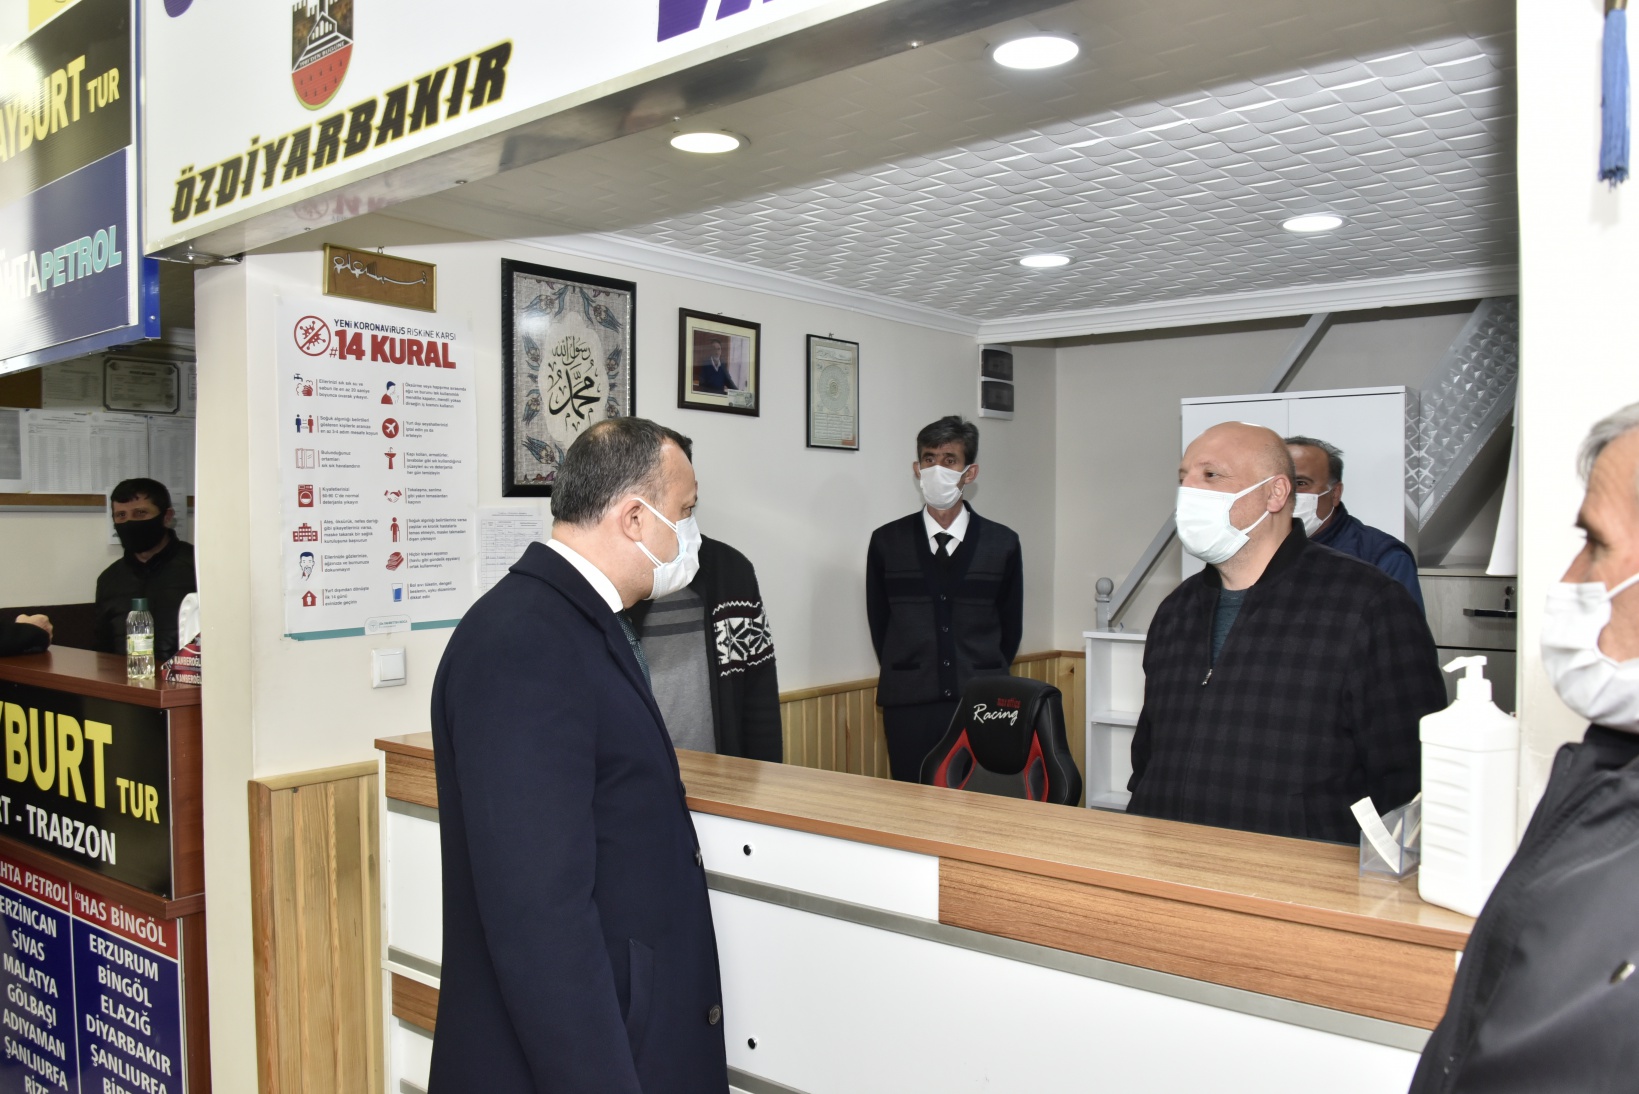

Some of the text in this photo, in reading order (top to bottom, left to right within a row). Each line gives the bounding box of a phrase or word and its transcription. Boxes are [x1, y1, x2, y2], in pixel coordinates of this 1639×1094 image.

[87, 67, 120, 113] TUR
[171, 38, 513, 225] ÖZDİYARBAKIR
[371, 334, 456, 369] KURAL
[973, 703, 1019, 726] Racing
[0, 701, 160, 824] BURT TUR
[26, 803, 116, 865] TRABZON
[25, 871, 69, 905] PETROL
[0, 896, 57, 938] ERZİNCAN
[80, 893, 107, 922] HAS
[111, 904, 167, 947] BİNGÖL
[12, 927, 45, 961] SİVAS
[89, 932, 159, 981] ERZURUM
[3, 953, 58, 998] MALATYA
[98, 964, 152, 1008] BİNGÖL
[7, 983, 57, 1029] GÖLBAŞI
[101, 994, 151, 1036] ELAZIĞ
[3, 1008, 66, 1061] ADIYAMAN
[86, 1013, 171, 1076] DİYARBAKIR
[4, 1035, 68, 1091] ŞANLIURFA
[90, 1043, 167, 1094] ŞANLIURFA
